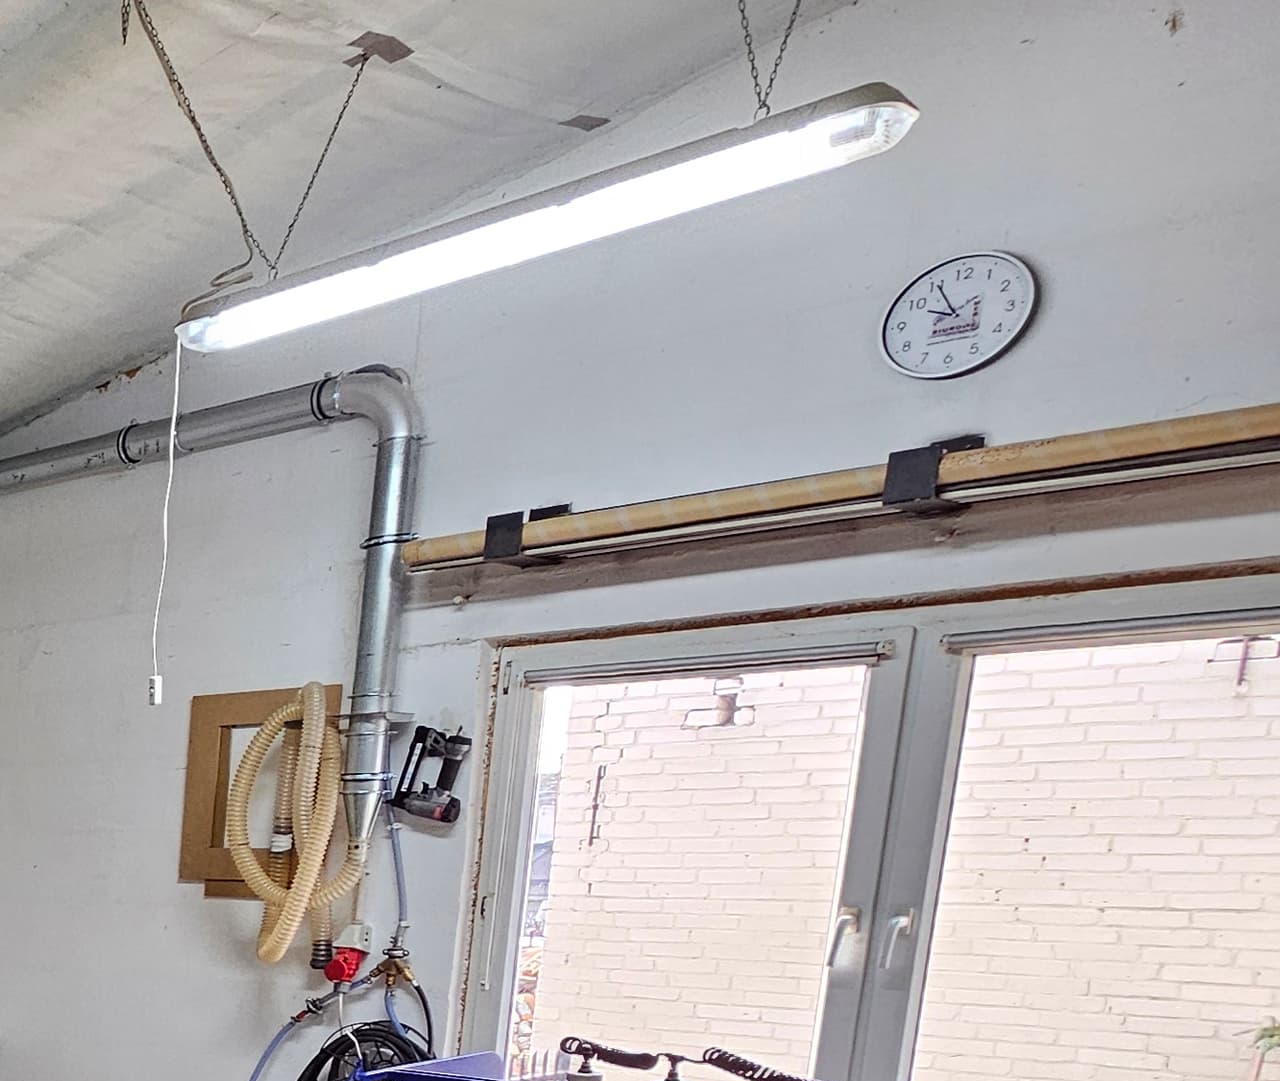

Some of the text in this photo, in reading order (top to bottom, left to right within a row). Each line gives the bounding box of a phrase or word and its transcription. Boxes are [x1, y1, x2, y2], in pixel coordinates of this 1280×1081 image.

[955, 267, 974, 281] 12
[987, 269, 992, 280] 1
[1000, 280, 1011, 293] 2
[908, 298, 927, 311] 10
[1004, 300, 1016, 312] 3
[896, 322, 907, 334] 9
[992, 322, 1003, 333] 4
[902, 341, 912, 352] 8
[969, 343, 980, 355] 5
[920, 352, 929, 365] 7
[943, 352, 954, 365] 6
